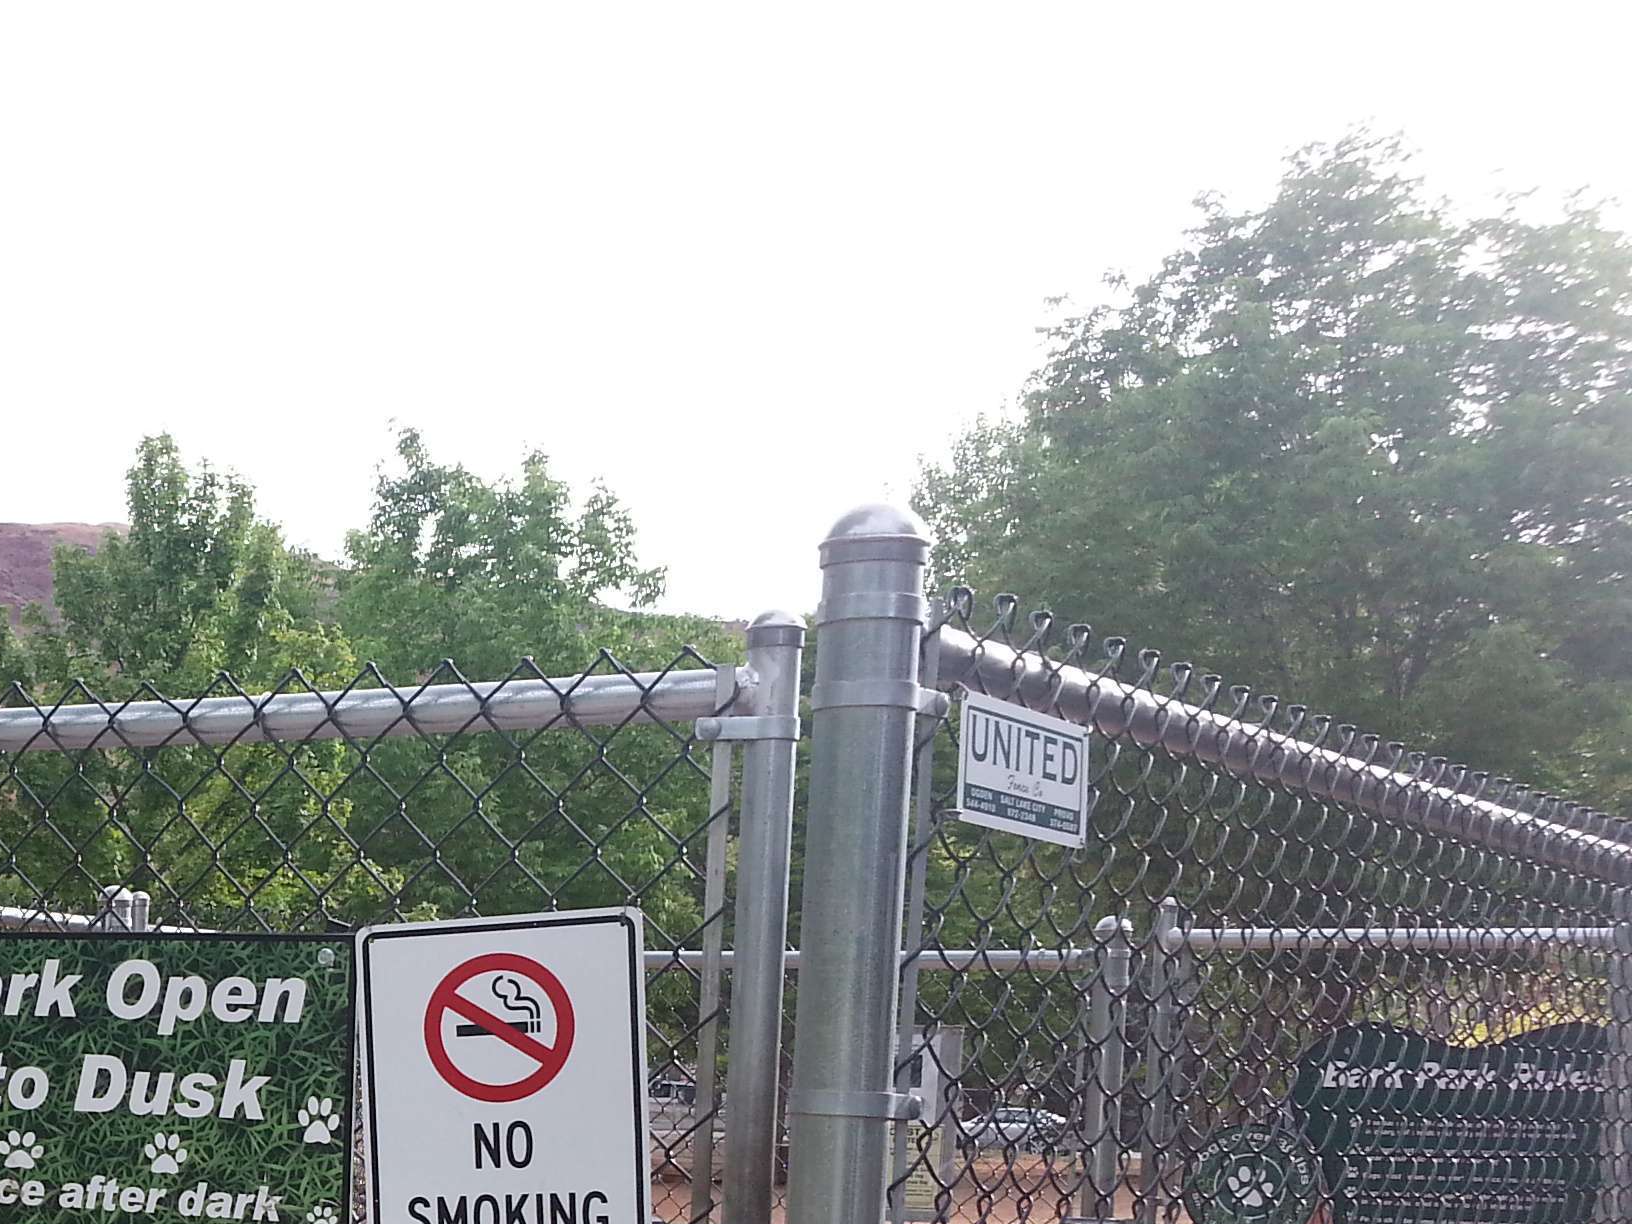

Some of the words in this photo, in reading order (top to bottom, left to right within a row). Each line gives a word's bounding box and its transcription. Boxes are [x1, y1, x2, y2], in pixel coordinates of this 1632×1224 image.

[972, 714, 1077, 785] UNITED
[1032, 804, 1046, 814] CITY
[106, 959, 307, 1036] Open
[73, 1054, 271, 1120] Dusk
[1323, 1061, 1403, 1089] Bark
[1418, 1061, 1496, 1090] Park
[473, 1120, 533, 1169] NO
[1294, 1157, 1310, 1185] lbs
[58, 1175, 165, 1215] after
[178, 1181, 281, 1222] dark
